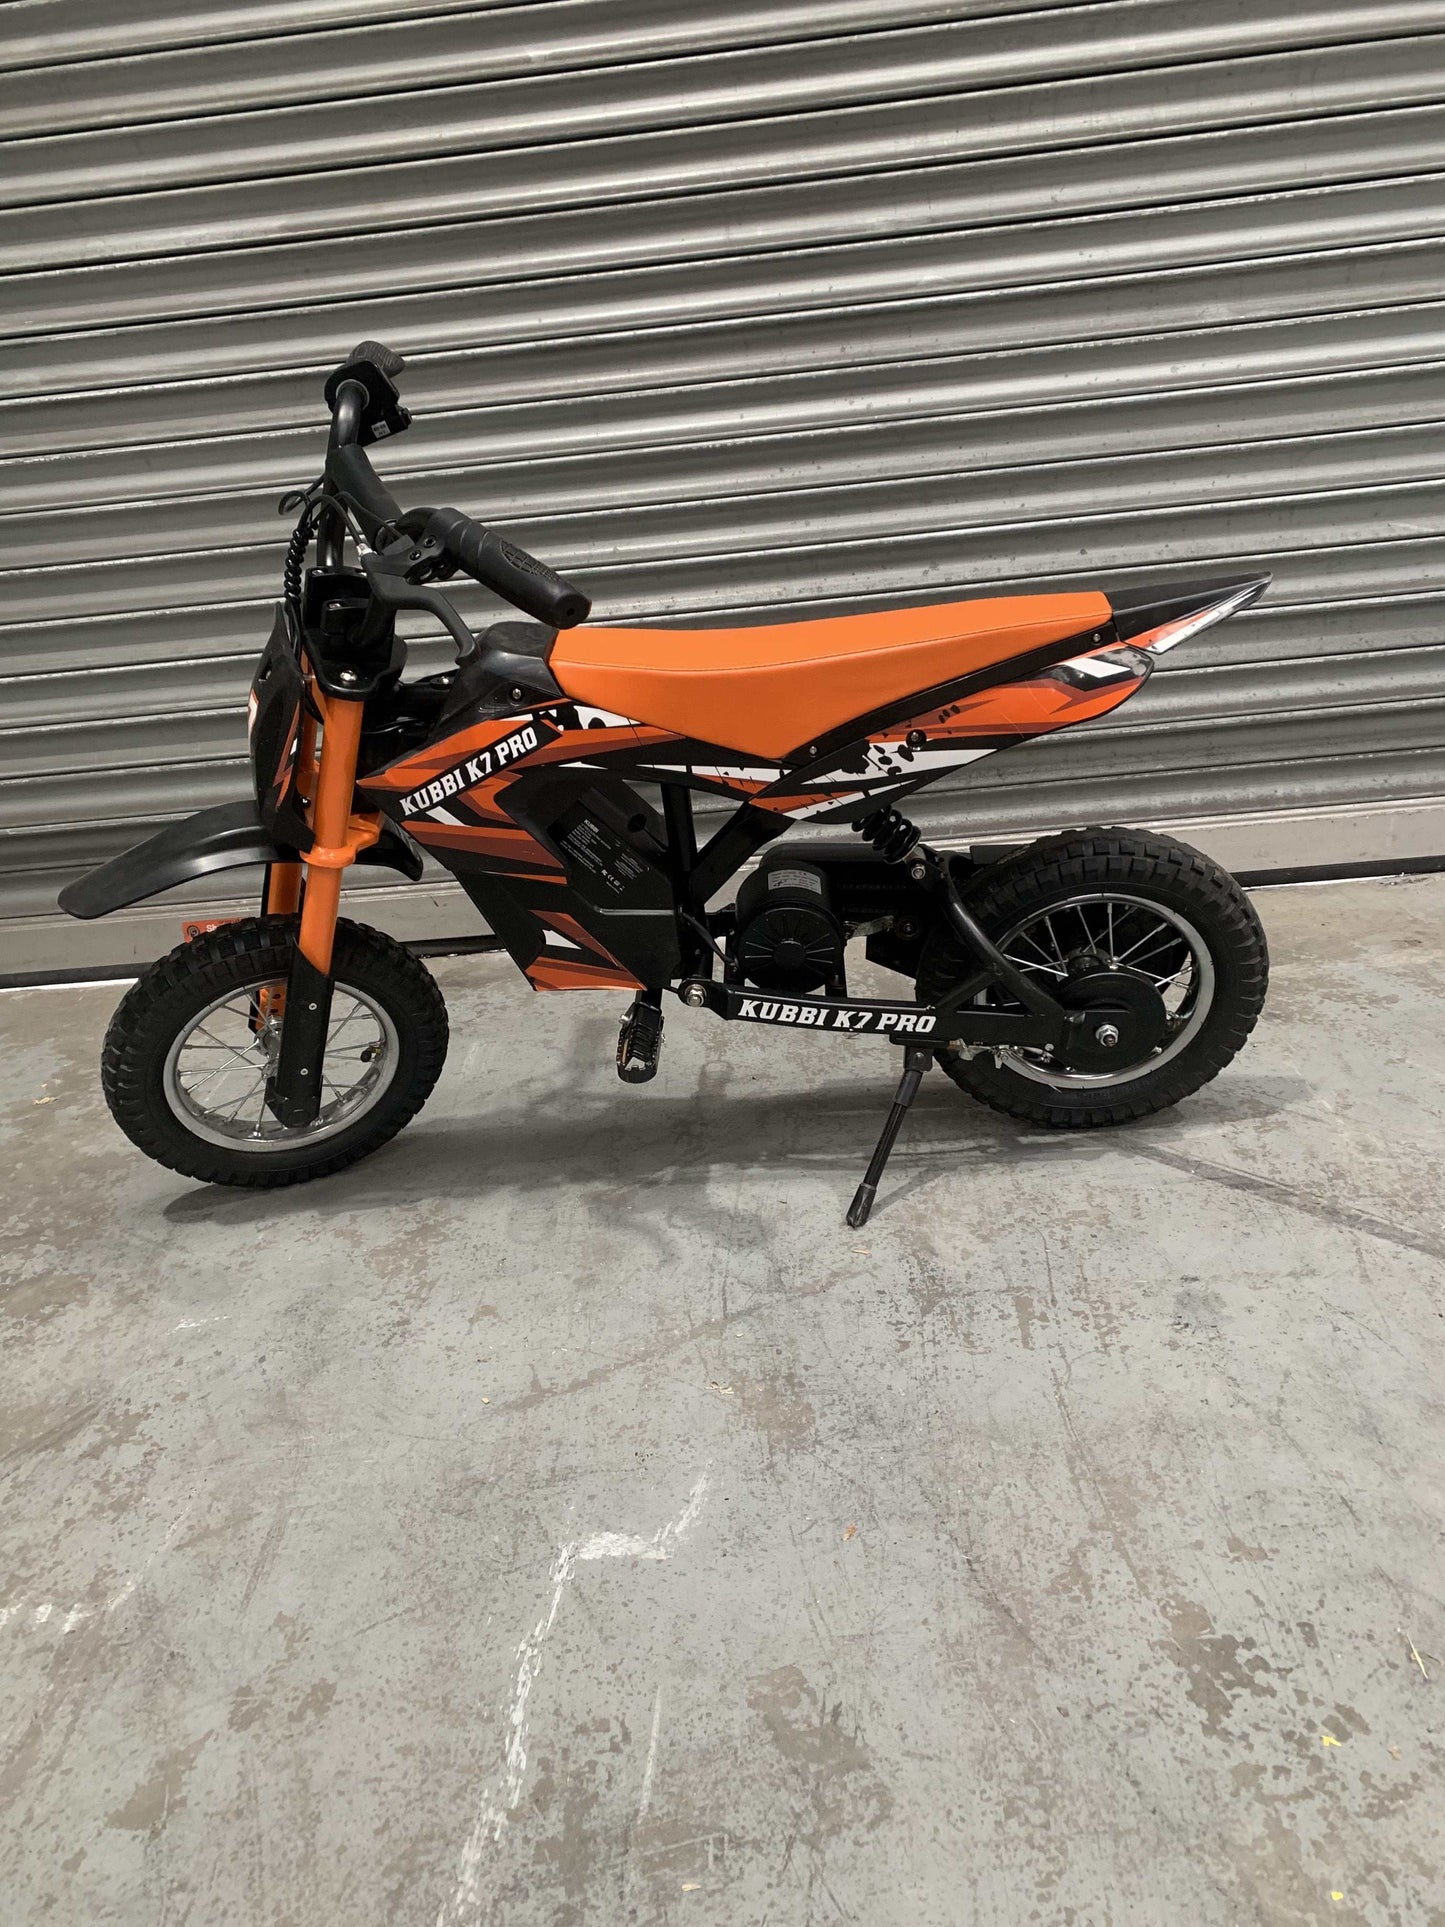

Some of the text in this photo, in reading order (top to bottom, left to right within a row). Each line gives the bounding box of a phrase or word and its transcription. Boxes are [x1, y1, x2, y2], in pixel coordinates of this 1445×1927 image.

[399, 726, 538, 816] KUBBI K7 PRO
[737, 999, 937, 1033] KUBBI K7 PRO
